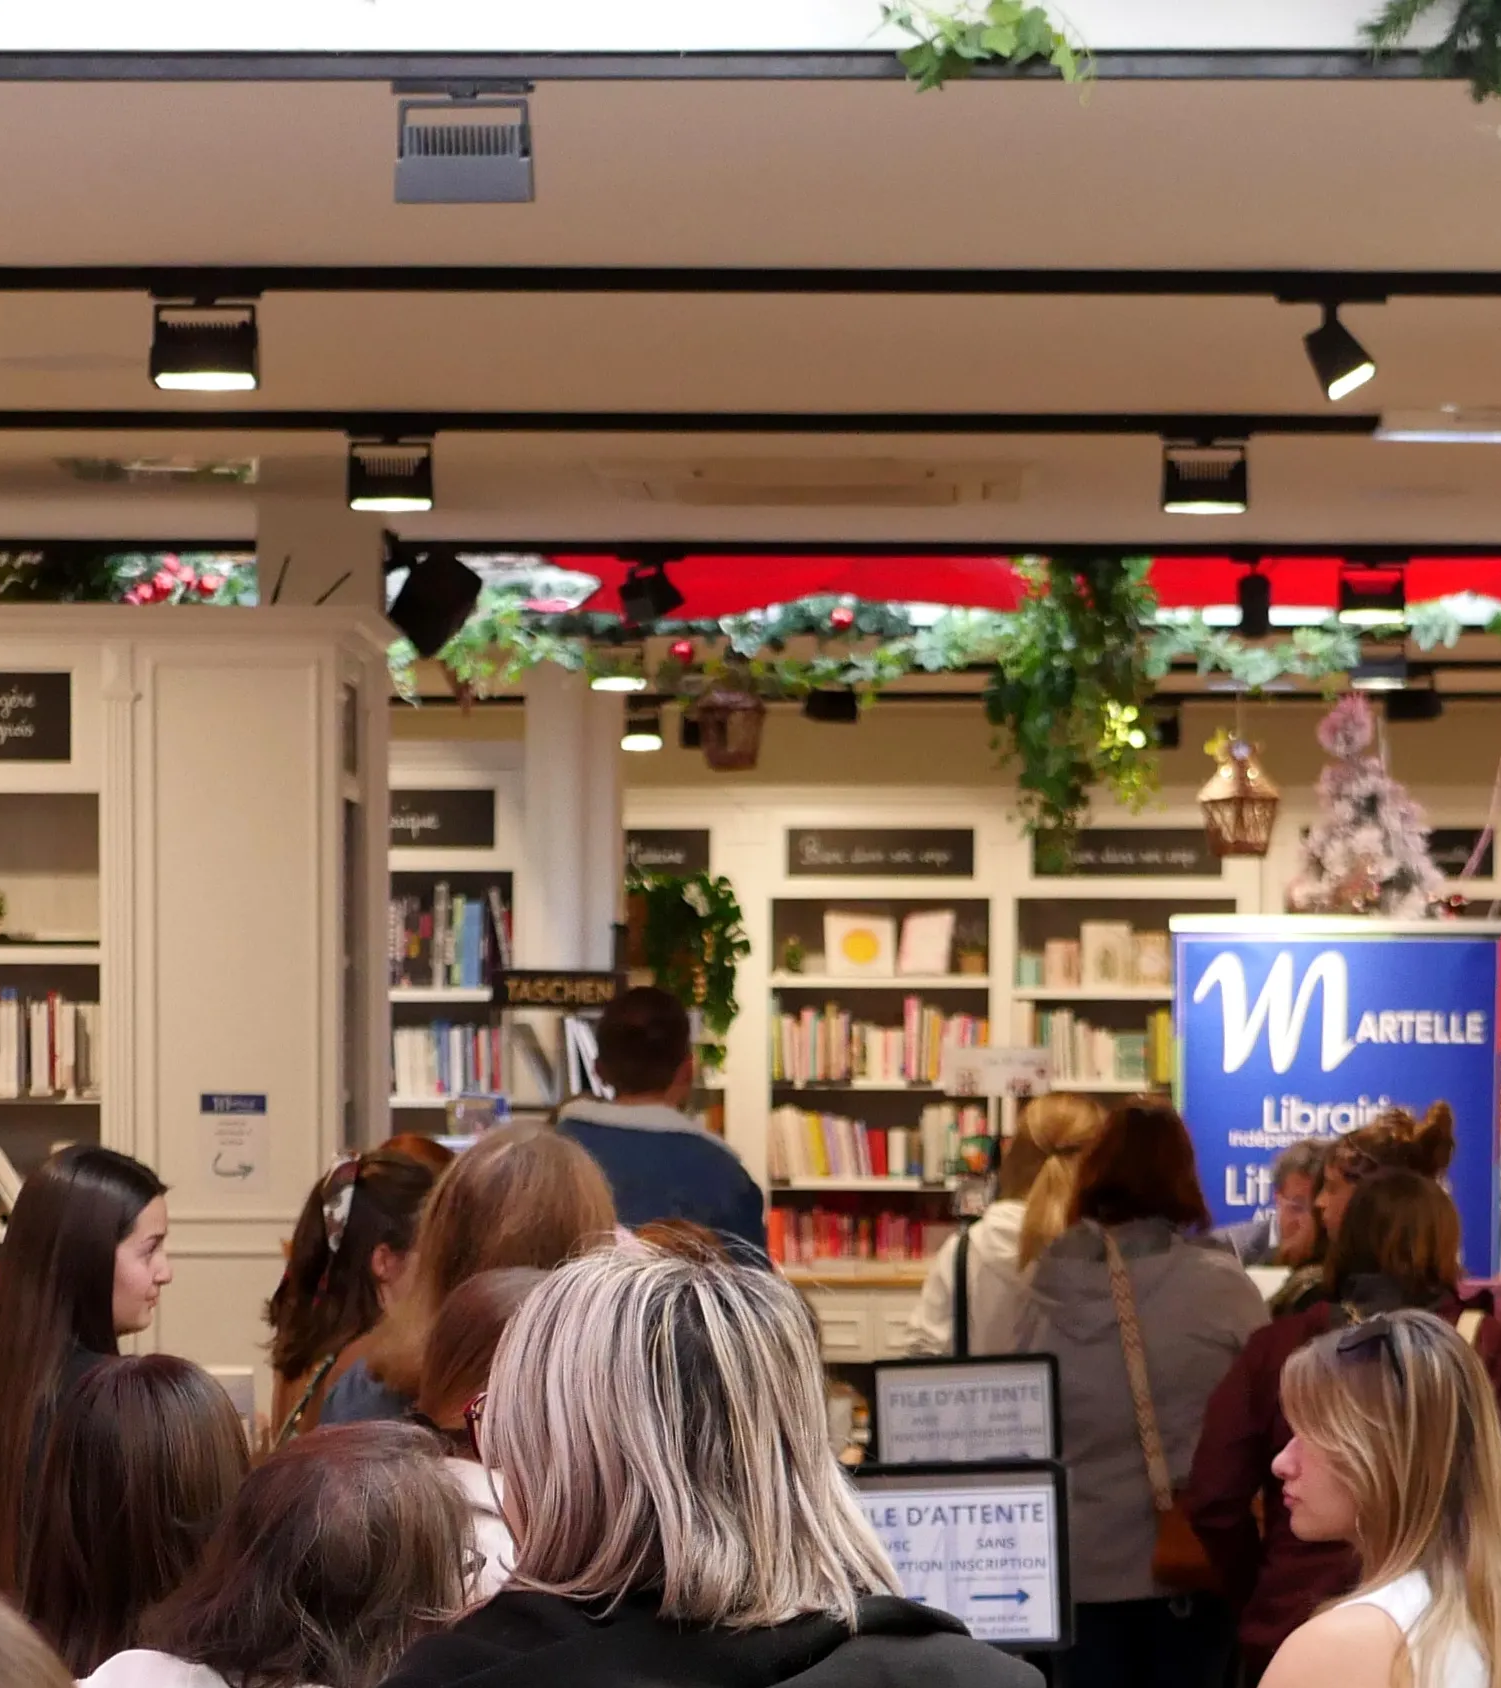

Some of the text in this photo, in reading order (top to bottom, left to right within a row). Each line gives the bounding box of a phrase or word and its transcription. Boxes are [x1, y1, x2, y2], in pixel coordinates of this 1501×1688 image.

[505, 977, 616, 1004] TASCHEN
[889, 1384, 1043, 1408] FILE D'ATTENTE
[906, 1502, 1046, 1528] D'ATTENTE
[976, 1536, 1016, 1551] SANS
[950, 1556, 1047, 1572] INSCRIPTION
